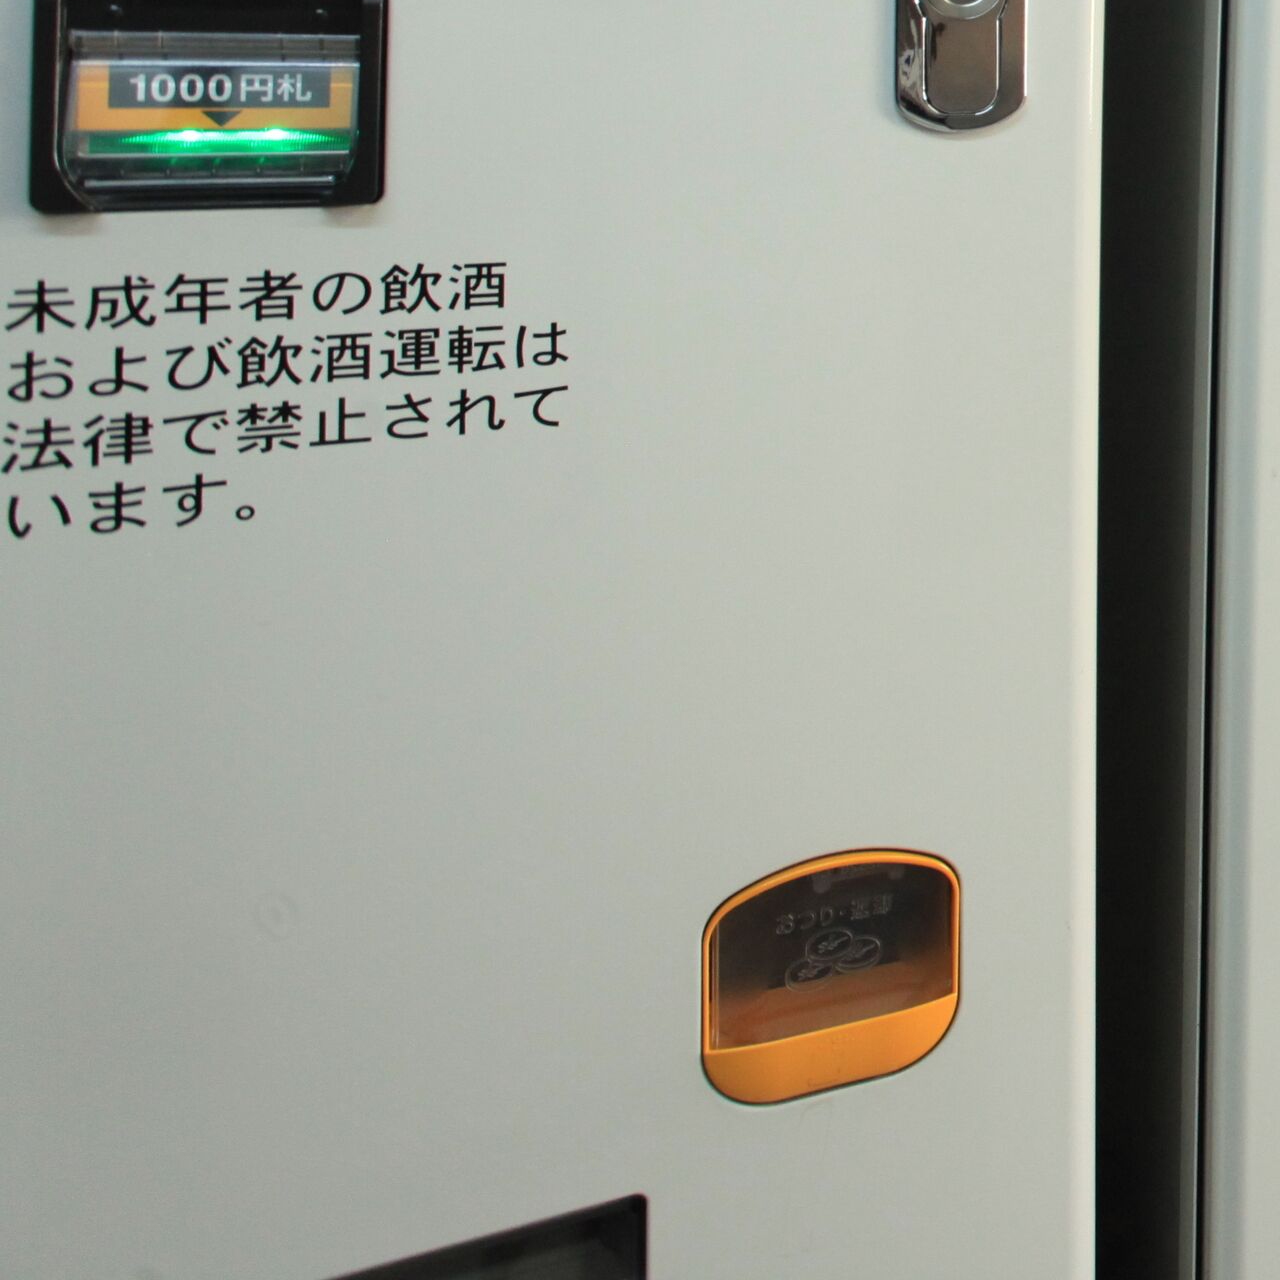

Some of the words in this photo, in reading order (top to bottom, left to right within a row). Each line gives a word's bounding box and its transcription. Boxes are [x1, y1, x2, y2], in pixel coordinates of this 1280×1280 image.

[128, 69, 314, 108] 1000円札
[5, 261, 508, 335] 未成年者の飲酒
[6, 321, 570, 402] および飲酒運転は
[1, 385, 570, 475] 法律で禁止されて
[8, 473, 256, 540] います。
